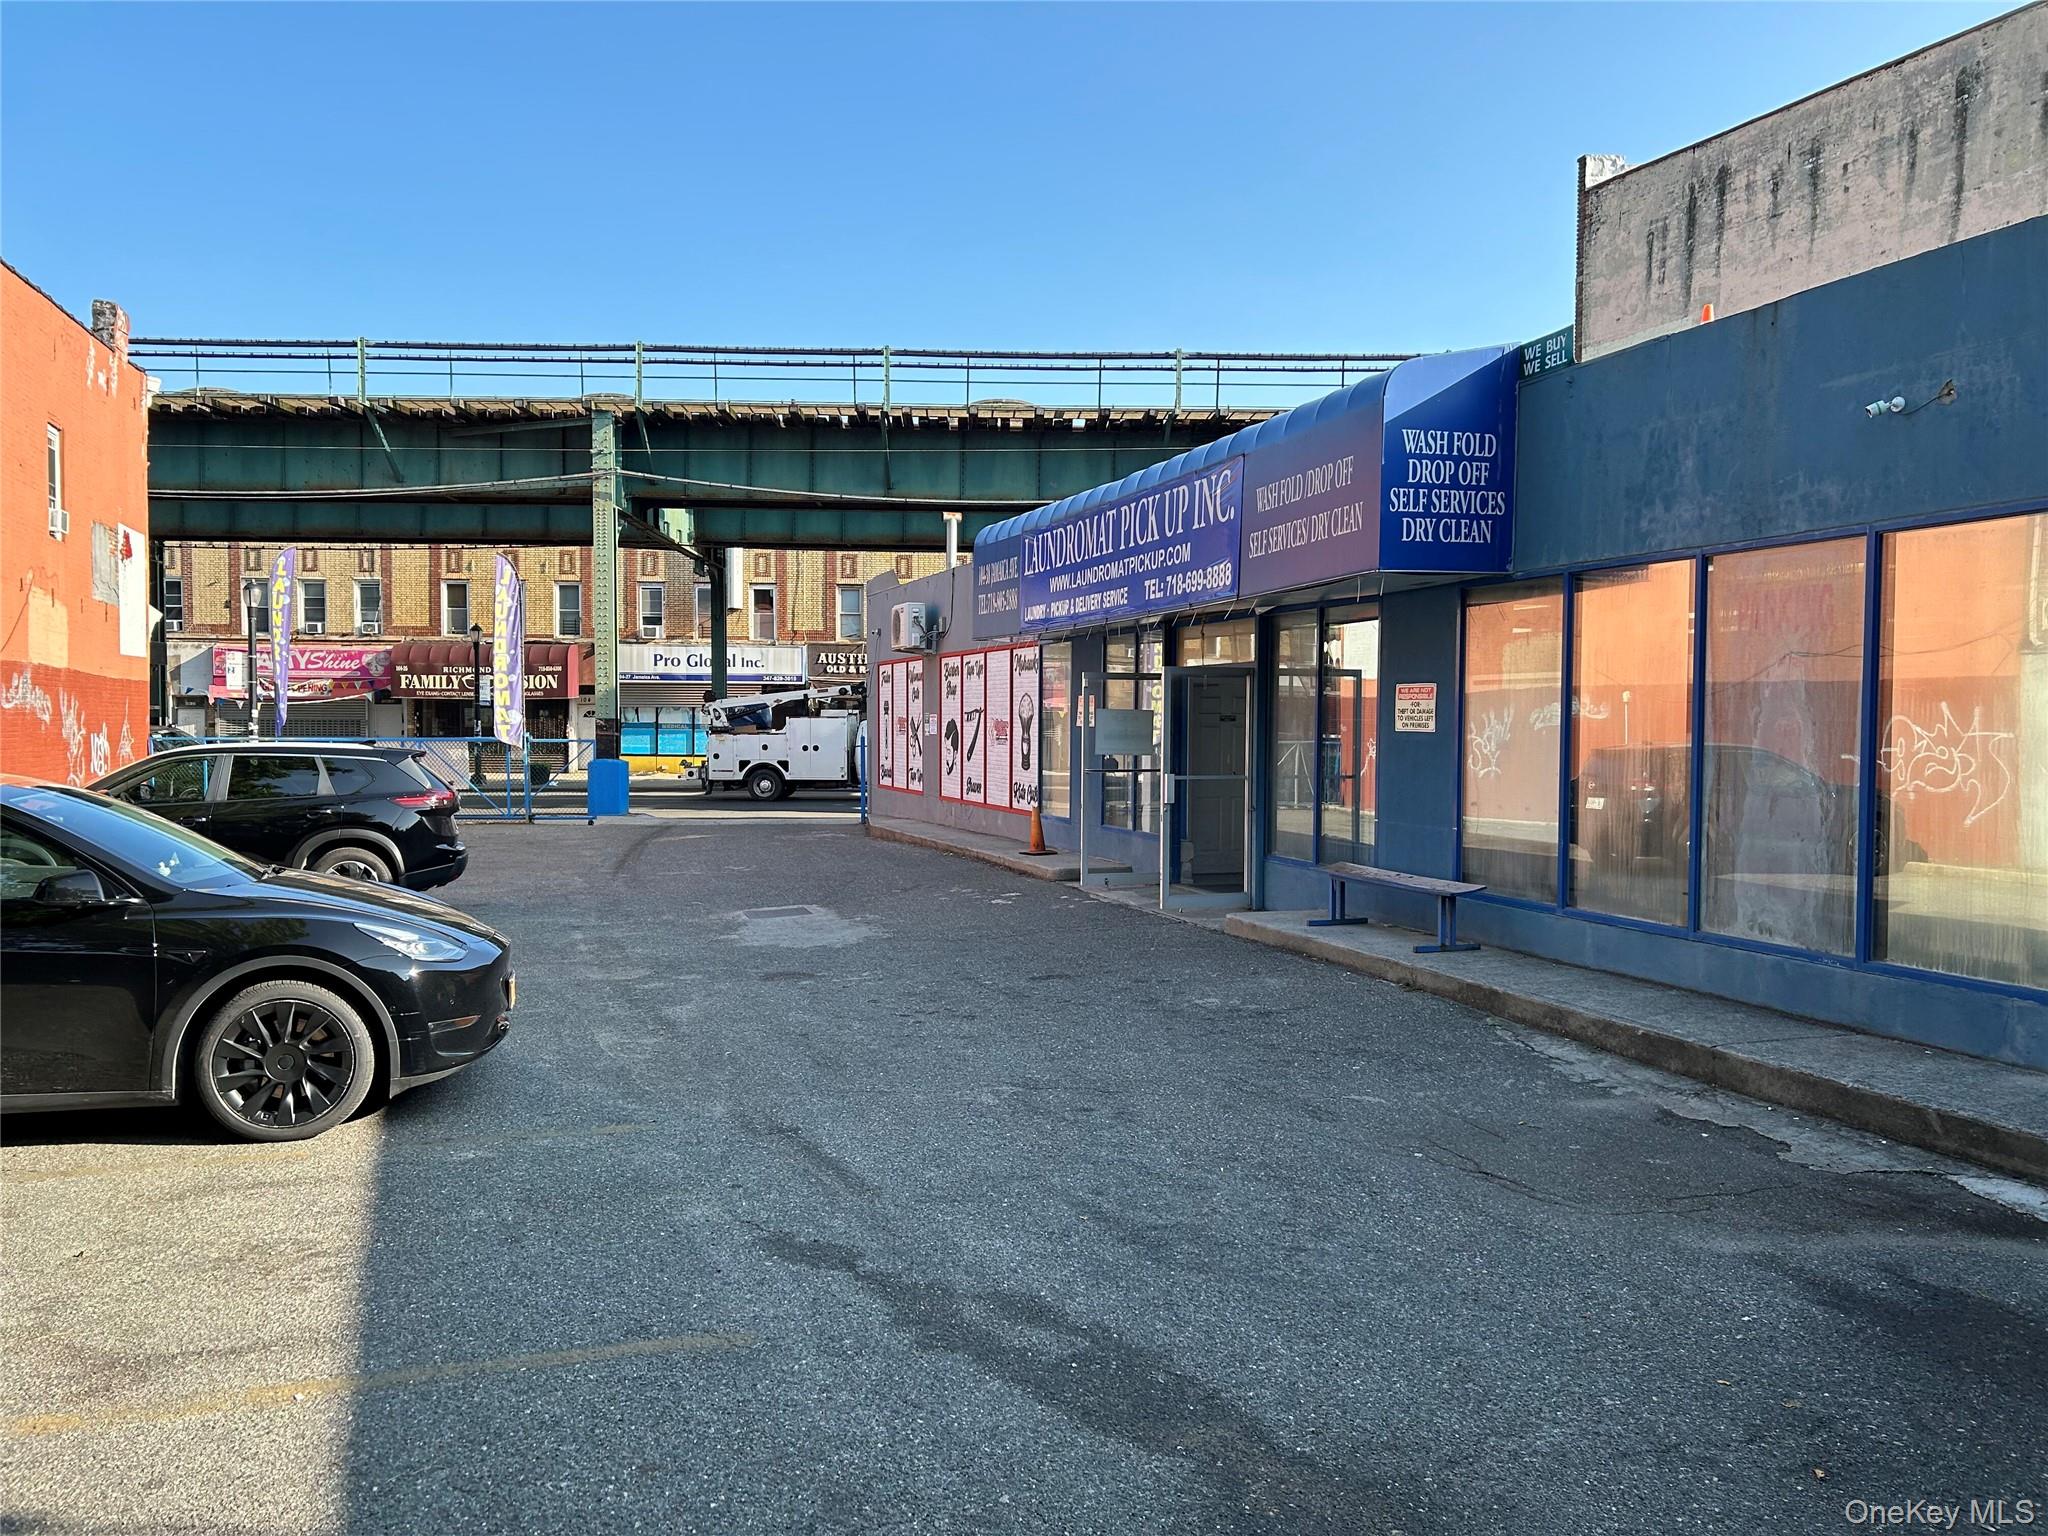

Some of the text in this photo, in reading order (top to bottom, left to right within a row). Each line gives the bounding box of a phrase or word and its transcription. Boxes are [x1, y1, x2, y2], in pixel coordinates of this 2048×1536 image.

[1524, 334, 1567, 361] WE BUY
[1524, 352, 1568, 376] WE SELL
[1402, 429, 1497, 457] WASH FOLD
[1256, 481, 1279, 514] WASH
[1280, 474, 1303, 506] FOLD
[1335, 456, 1354, 489] OFF
[1408, 459, 1490, 486] DROP OFF
[1389, 488, 1505, 515] SELF SERVICES
[1024, 470, 1235, 576] LAUNDROMAT PICK UP INC.
[1248, 528, 1268, 559] SELF
[1310, 511, 1331, 543] DRY
[1331, 502, 1364, 537] CLEAN
[1402, 518, 1492, 544] DRY CLEAN
[1050, 542, 1191, 592] WWW.LAUNDROMATPICKUP.COM
[1144, 563, 1232, 600] TEL: 718-699-8888
[1024, 604, 1046, 621] LAUNDRY
[1050, 600, 1069, 618] PICKUP
[1070, 598, 1074, 614] &
[1075, 593, 1102, 613] DELIVERY
[1102, 587, 1128, 608] SERVICE
[654, 653, 765, 668] Pro Gloal Inc.
[826, 665, 846, 674] OLD
[849, 666, 856, 674] &
[400, 674, 462, 689] FAMILY
